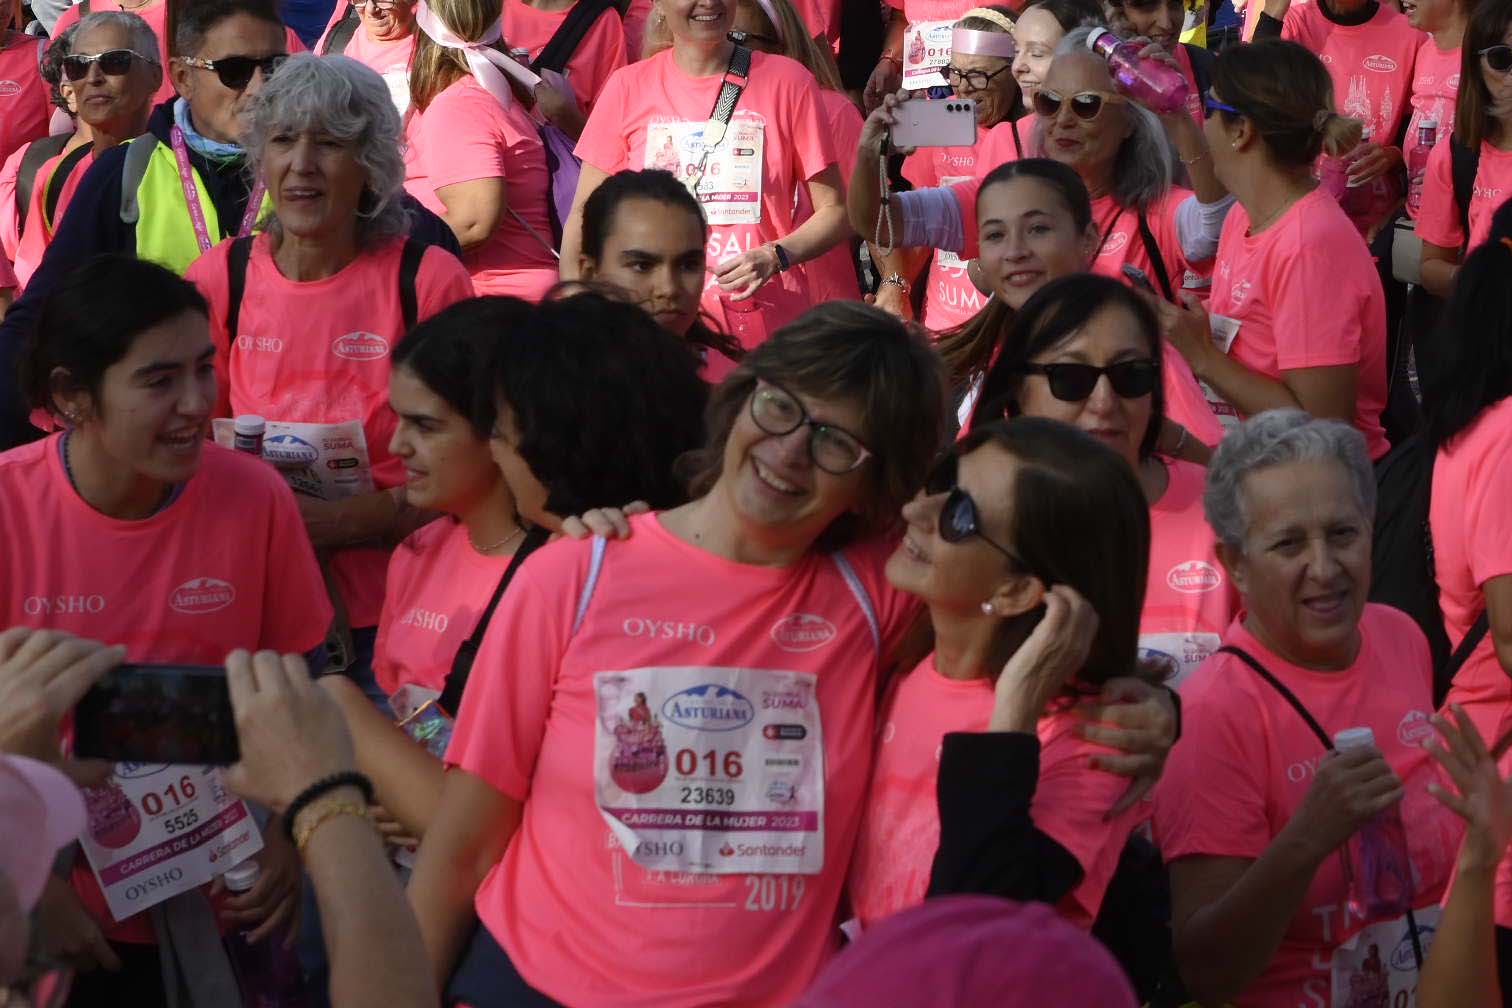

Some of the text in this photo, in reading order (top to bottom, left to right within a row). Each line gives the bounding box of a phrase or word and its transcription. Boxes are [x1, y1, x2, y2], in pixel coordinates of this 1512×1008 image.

[938, 281, 982, 309] SUM
[24, 594, 106, 616] OYSHO
[623, 617, 716, 646] OYSHO
[669, 701, 748, 723] ASTURIANA
[675, 748, 744, 779] 016
[141, 774, 197, 816] 016
[680, 787, 736, 807] 23639
[164, 809, 200, 835] 5525
[621, 813, 682, 828] CARRERA
[686, 814, 704, 827] DE
[704, 814, 722, 827] LA
[722, 815, 767, 828] MUJER
[737, 842, 806, 859] Santander
[124, 867, 184, 901] OYSHO
[744, 876, 806, 912] 2019
